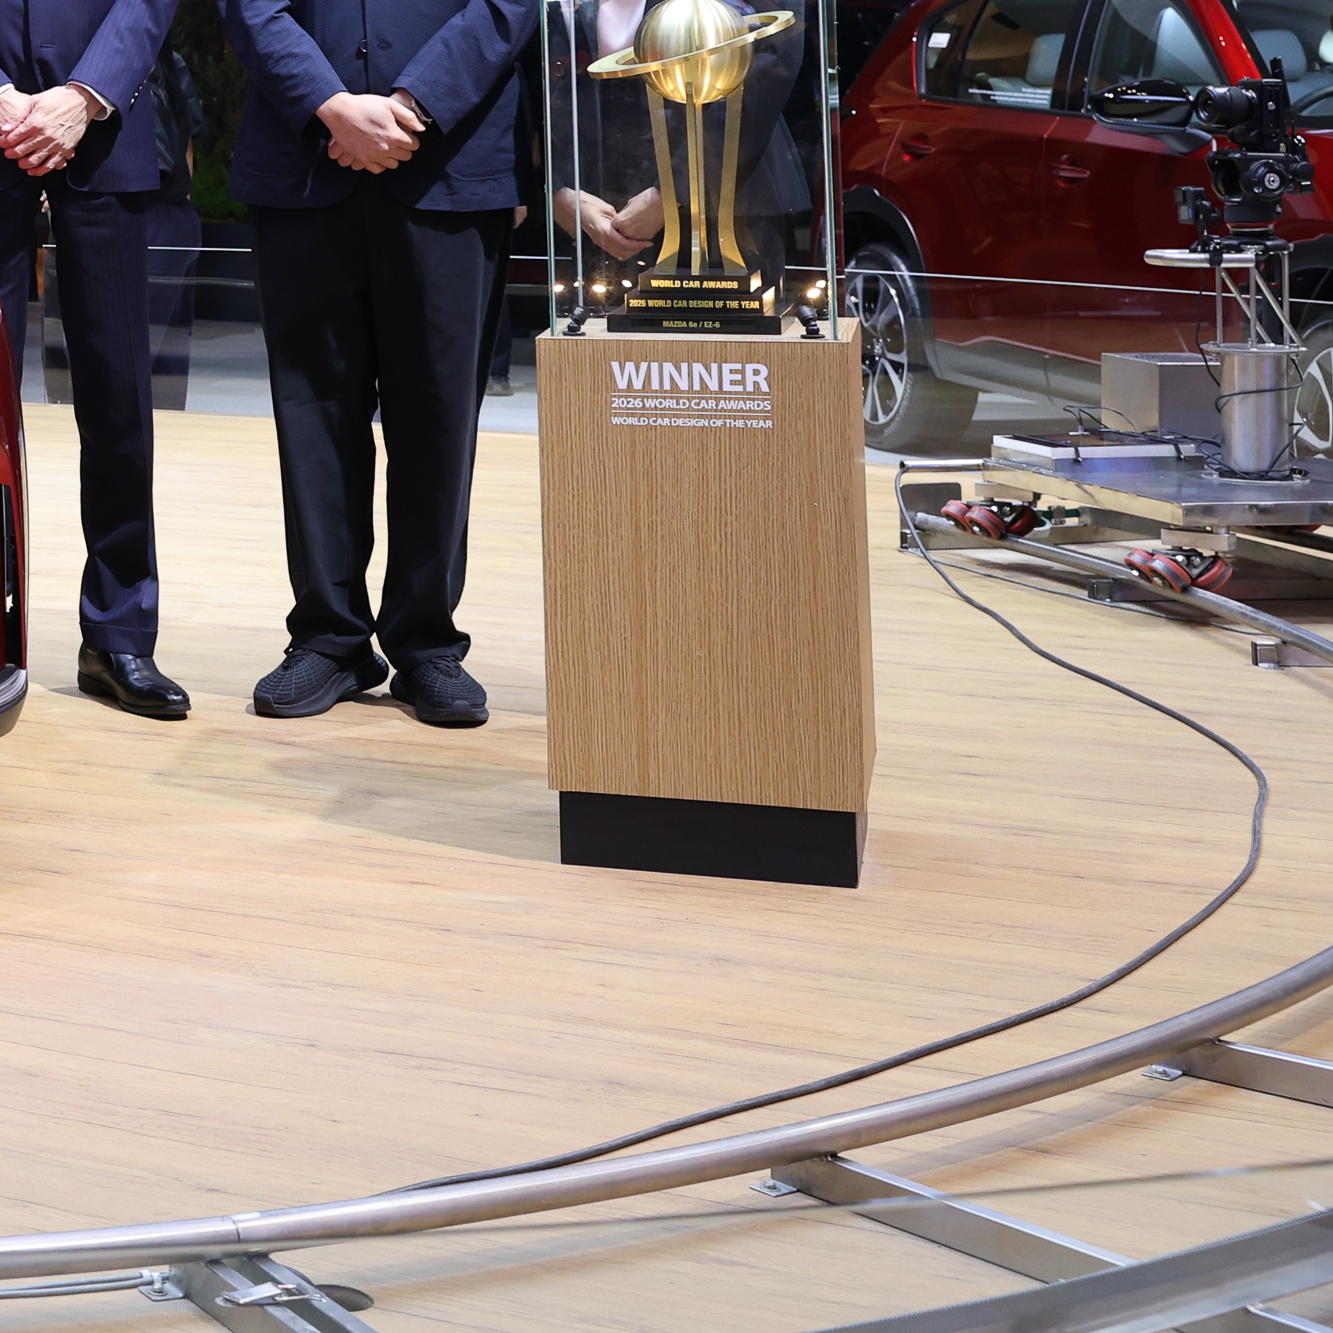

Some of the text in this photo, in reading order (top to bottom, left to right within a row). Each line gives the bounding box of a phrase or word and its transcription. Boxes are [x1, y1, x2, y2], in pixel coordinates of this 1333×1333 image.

[650, 279, 739, 289] WORLD CAR AWARDS
[629, 299, 760, 309] 2026 WORLD CAR DESIGN OF THE YEAR
[662, 320, 688, 328] MAZDA
[610, 361, 771, 393] WINNER
[611, 397, 772, 411] 2026 WORLD CAR AWARDS
[611, 416, 773, 429] WORLD CAR DESIGN OF THE YEAR
